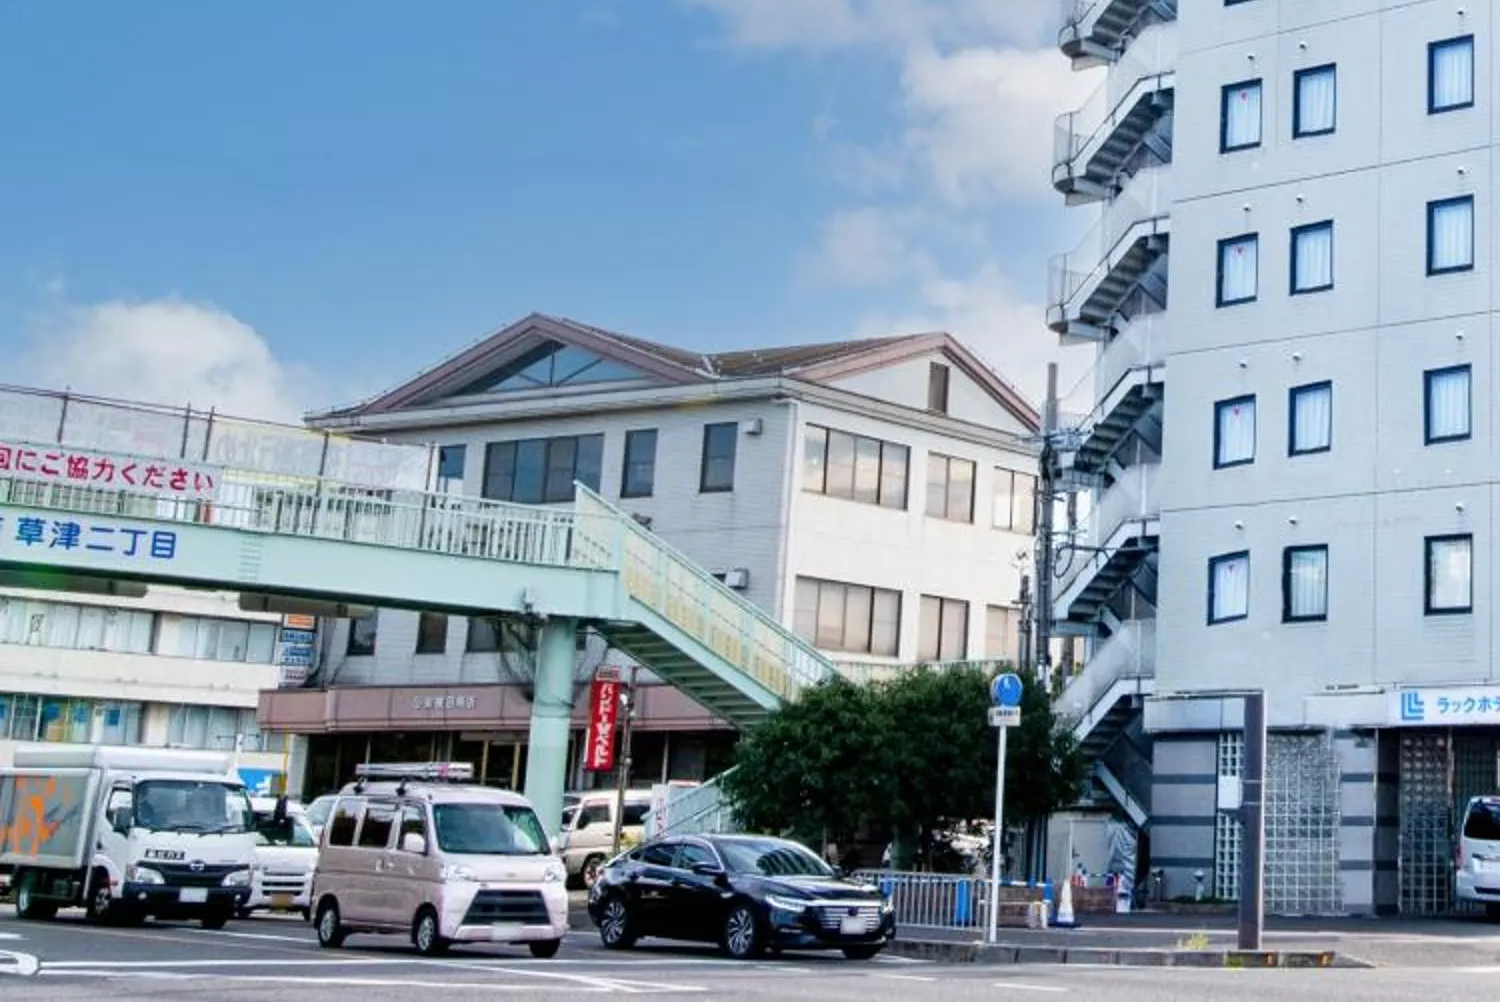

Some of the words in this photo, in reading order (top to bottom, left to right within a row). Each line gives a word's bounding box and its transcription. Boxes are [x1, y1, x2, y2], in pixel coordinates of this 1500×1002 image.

[15, 517, 177, 559] 草津二丁目
